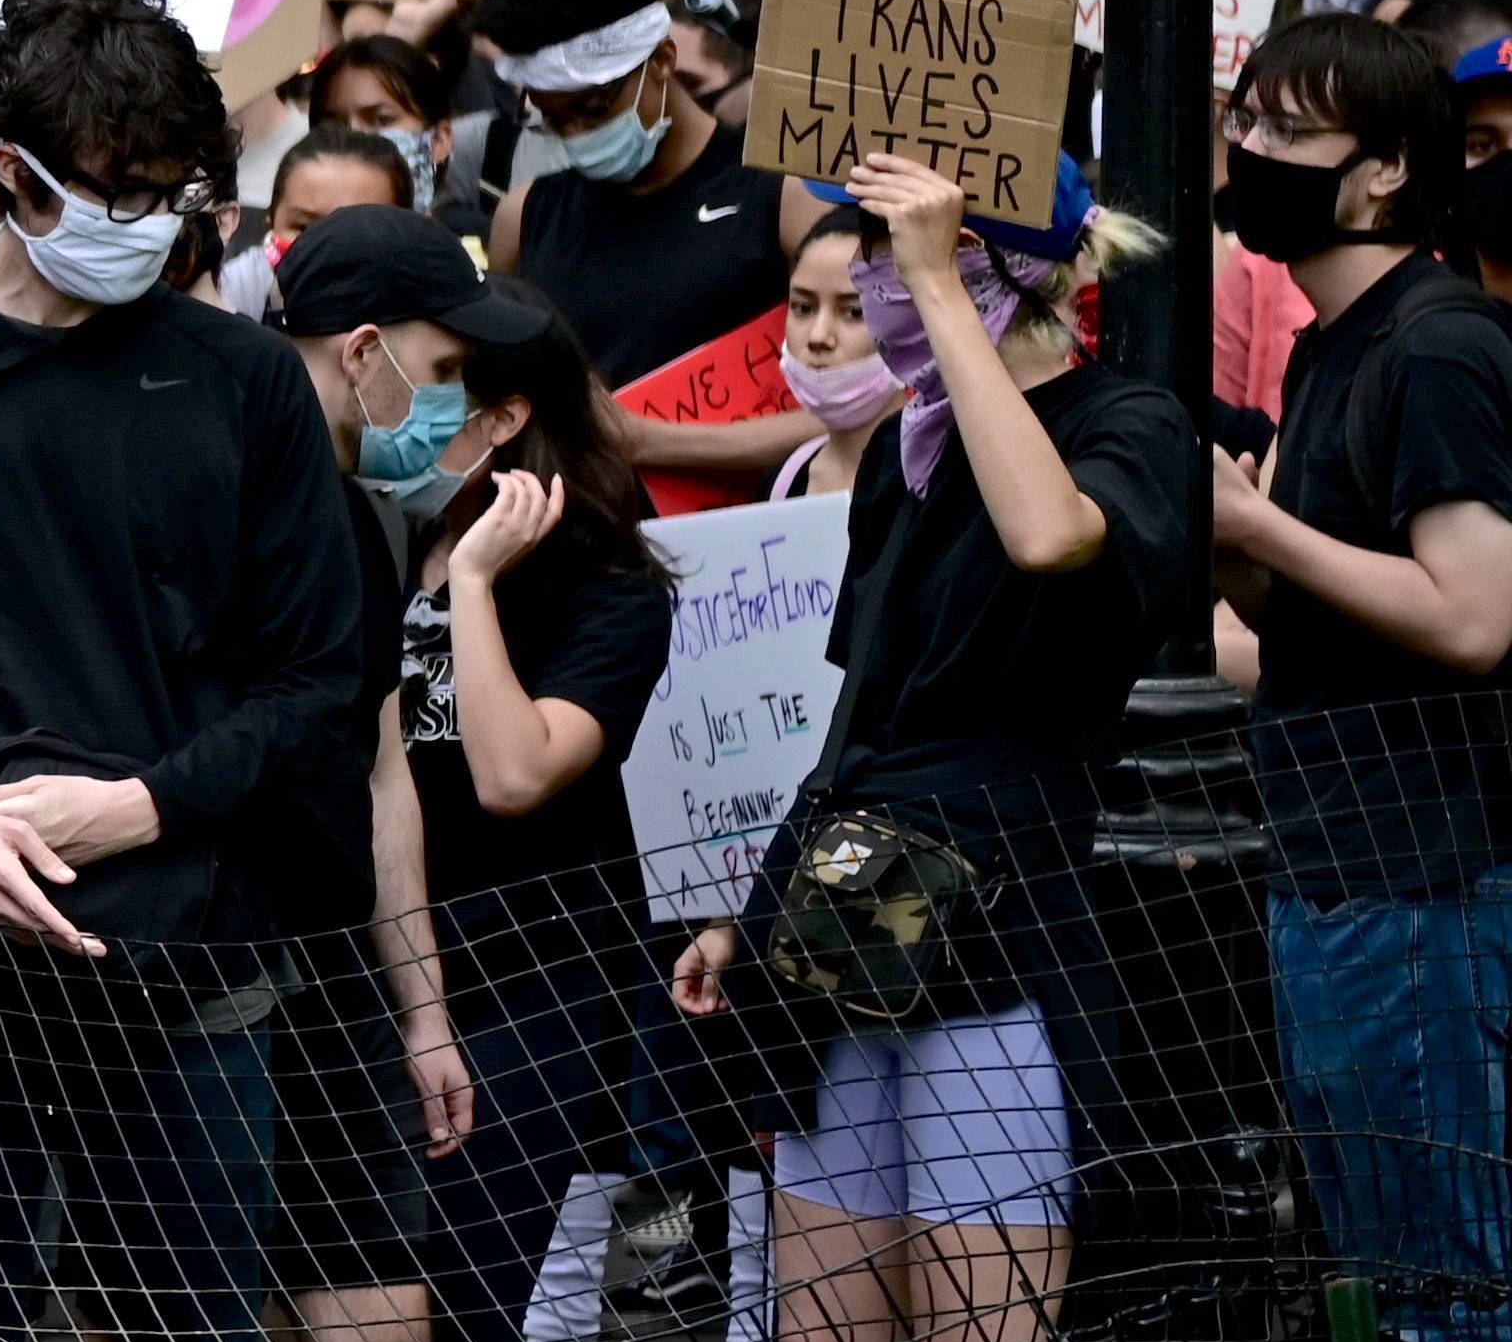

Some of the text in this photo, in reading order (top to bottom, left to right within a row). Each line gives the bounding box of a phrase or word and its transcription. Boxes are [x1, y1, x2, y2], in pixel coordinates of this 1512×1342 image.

[808, 48, 1000, 140] LIVES
[669, 692, 809, 768] IS JUST THE
[682, 788, 786, 841] BEGINNING
